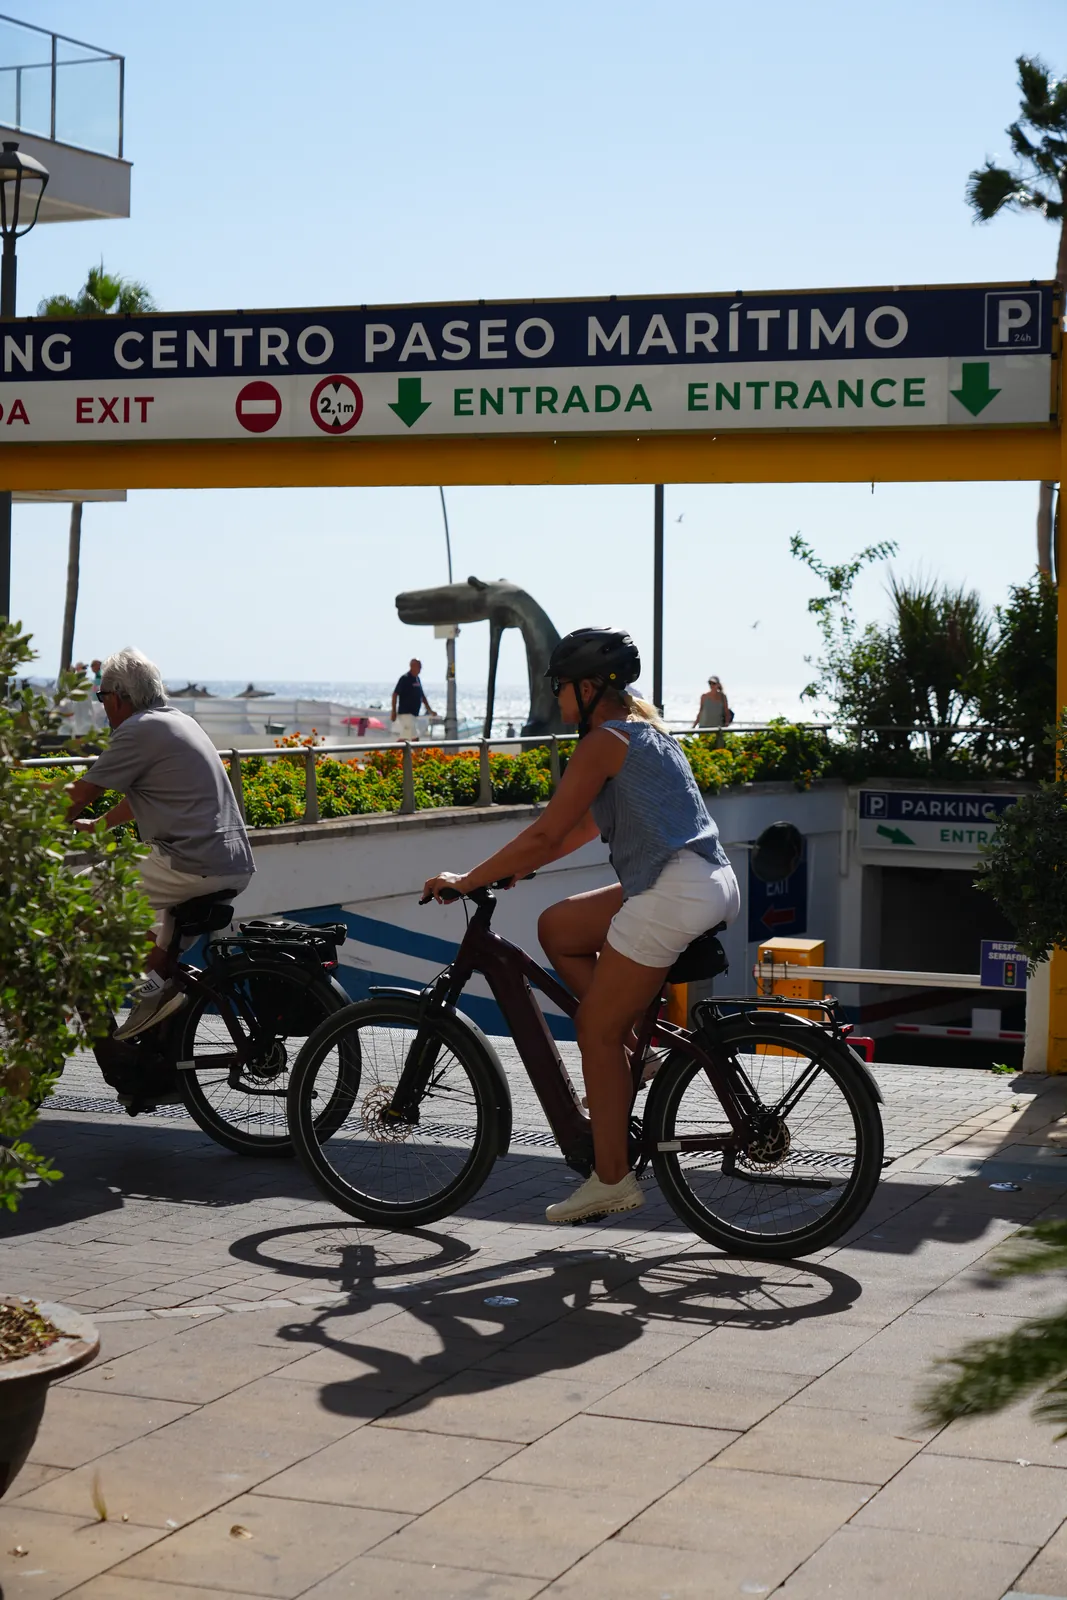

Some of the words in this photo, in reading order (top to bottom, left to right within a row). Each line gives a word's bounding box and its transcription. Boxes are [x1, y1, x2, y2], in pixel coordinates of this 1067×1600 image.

[998, 299, 1032, 343] P
[4, 333, 72, 372] NG
[113, 325, 335, 370] CENTRO
[364, 317, 556, 364] PASEO
[586, 302, 910, 357] MARÍTIMO
[1014, 333, 1032, 342] 24h
[0, 399, 30, 425] A
[76, 396, 154, 423] EXIT
[453, 383, 653, 416] ENTRADA
[687, 377, 927, 412] ENTRANCE
[870, 796, 884, 815] P
[901, 800, 995, 819] PARKING
